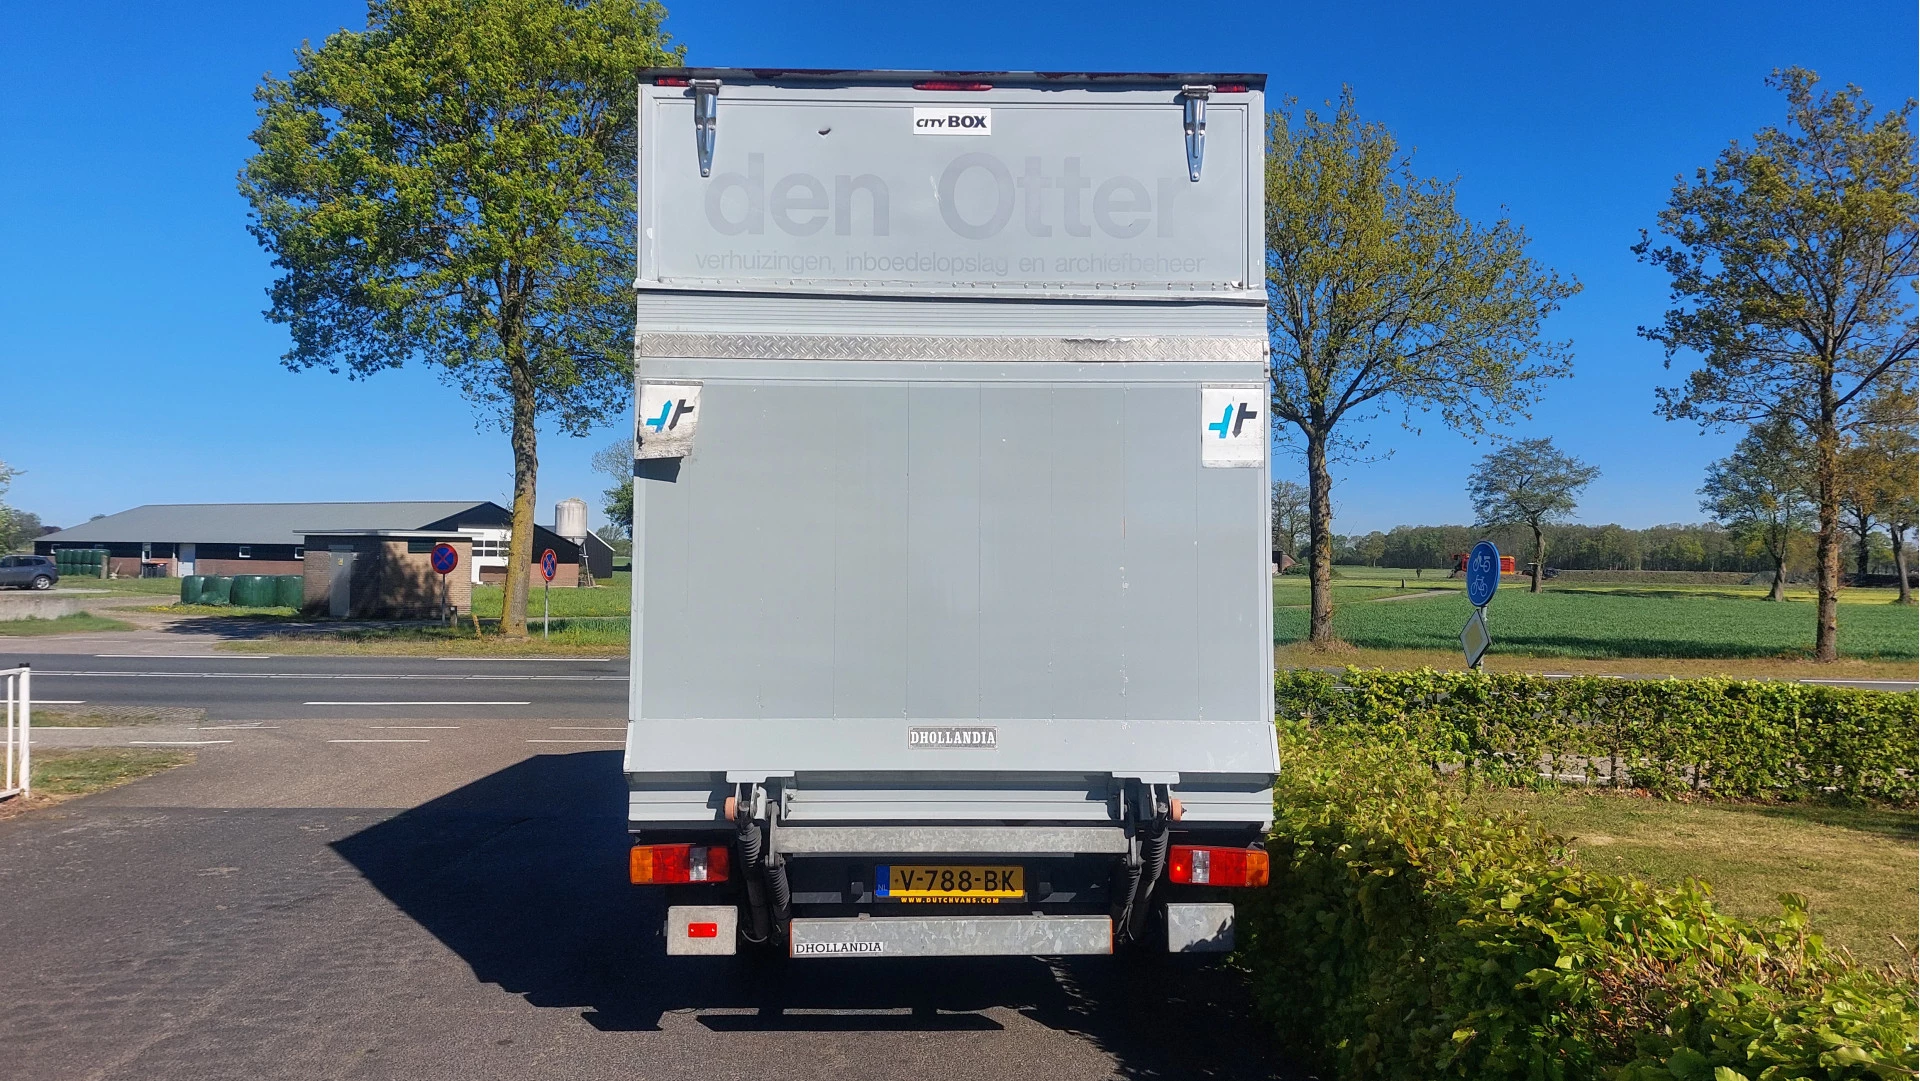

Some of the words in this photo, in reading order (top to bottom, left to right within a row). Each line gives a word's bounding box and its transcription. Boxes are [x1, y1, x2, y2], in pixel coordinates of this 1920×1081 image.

[916, 118, 946, 128] CITY
[948, 115, 988, 128] BOX
[704, 152, 890, 237] den
[937, 152, 1192, 240] Otter
[695, 250, 837, 275] verhuizingen,
[845, 251, 1009, 277] inboedelopslag
[1018, 255, 1045, 273] en
[1054, 252, 1206, 273] archiefbeheer
[910, 731, 996, 744] DHOLLANDIA
[900, 870, 1016, 892] V-788-BK
[877, 884, 888, 892] NL
[900, 896, 999, 904] WWW.DUTCHVANS.COM
[795, 942, 882, 954] DHOLLANDIA
